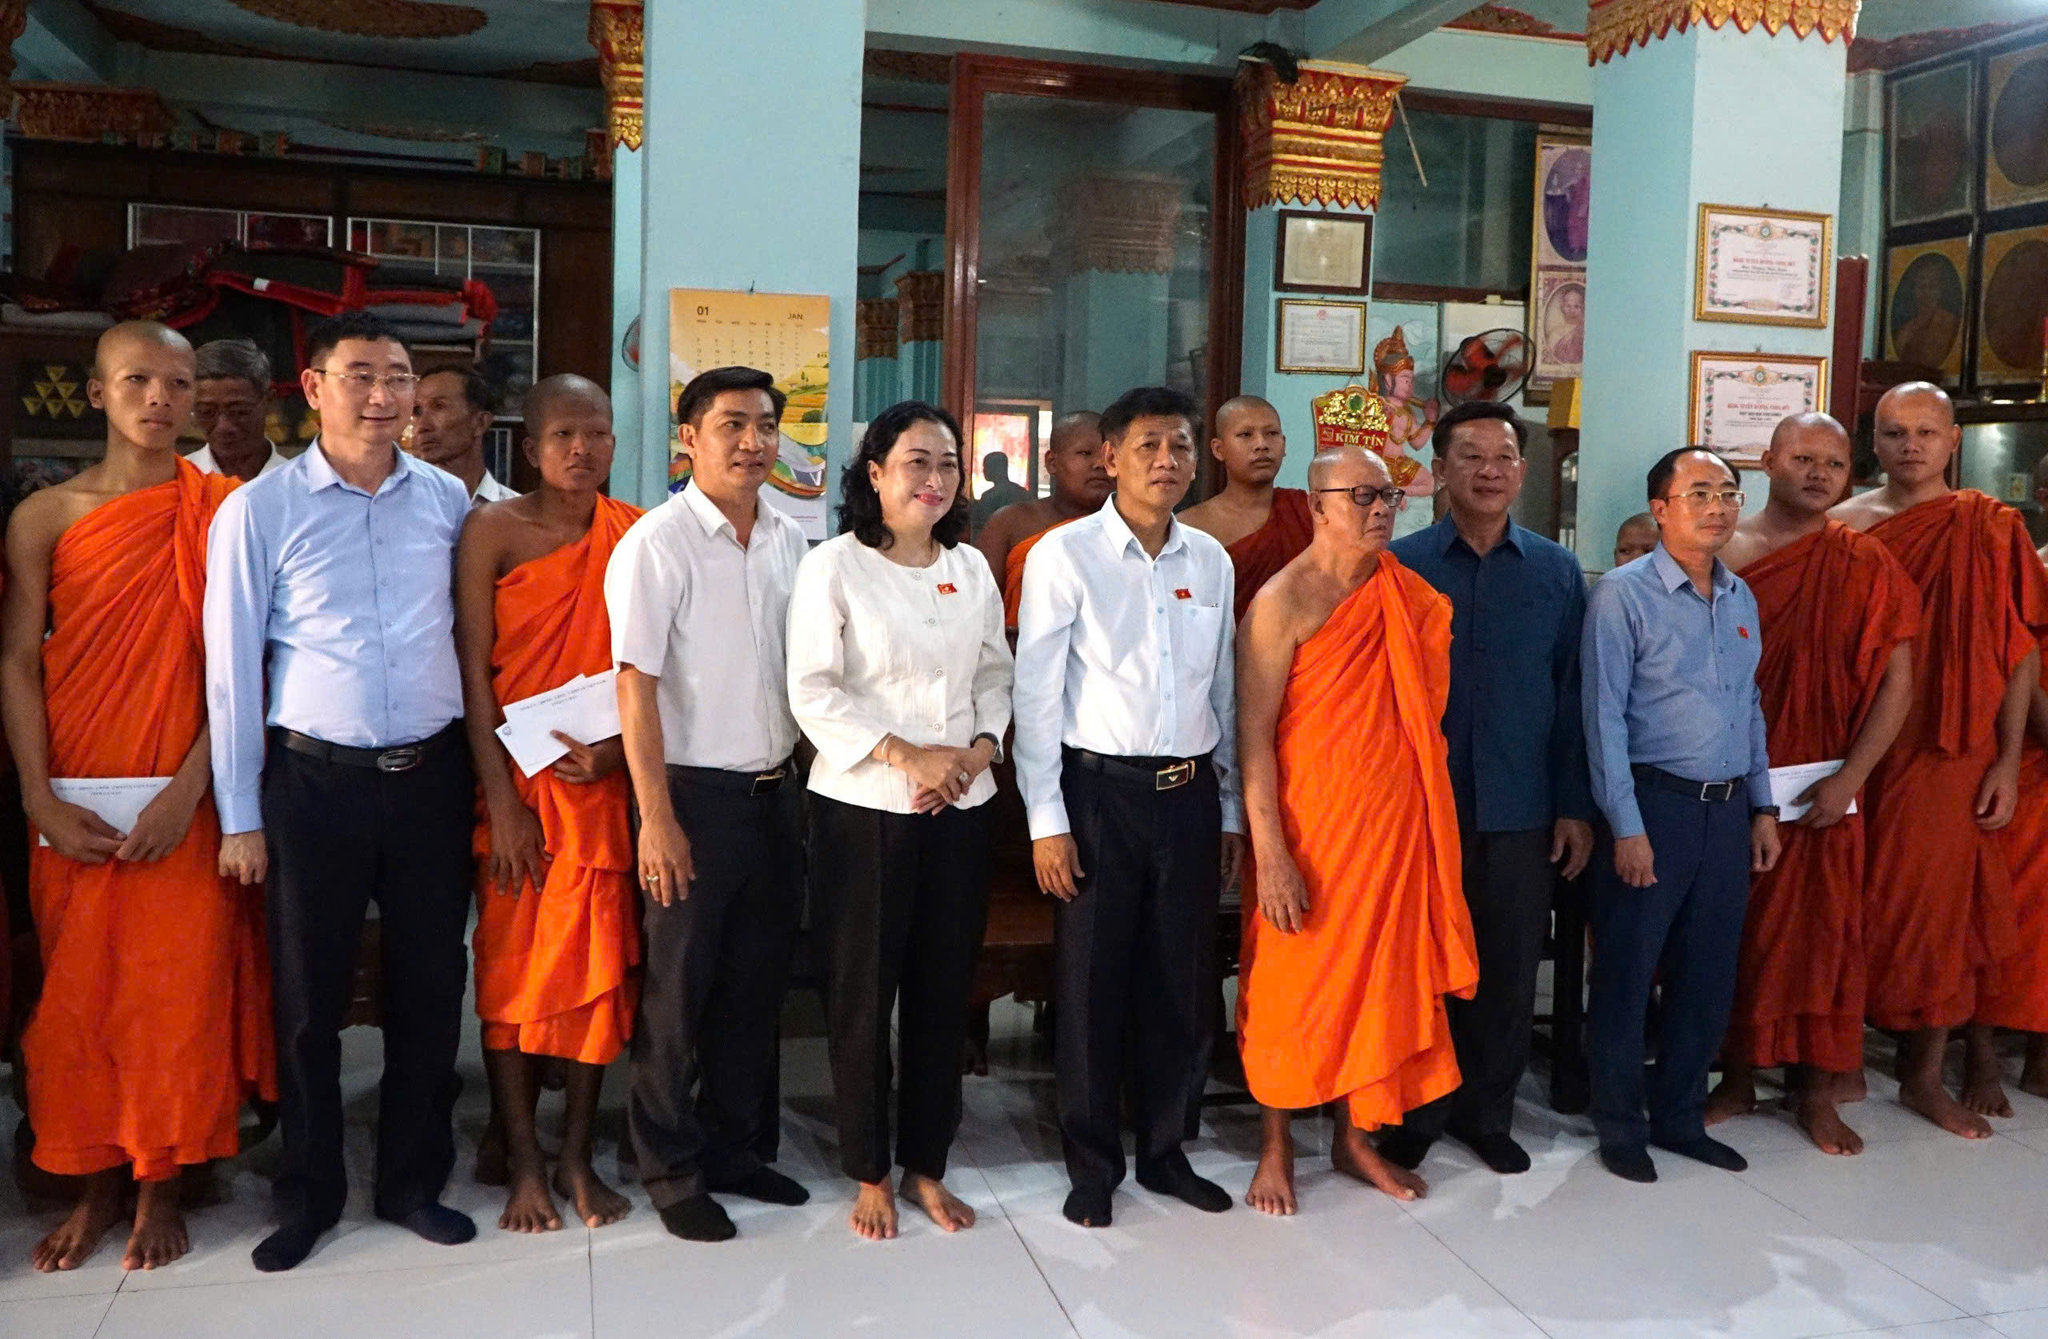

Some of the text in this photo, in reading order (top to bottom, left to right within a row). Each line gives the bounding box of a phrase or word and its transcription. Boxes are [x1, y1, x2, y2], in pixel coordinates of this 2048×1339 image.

[696, 306, 709, 316] 01
[1335, 433, 1360, 443] KIM
[1363, 434, 1385, 447] TÍN
